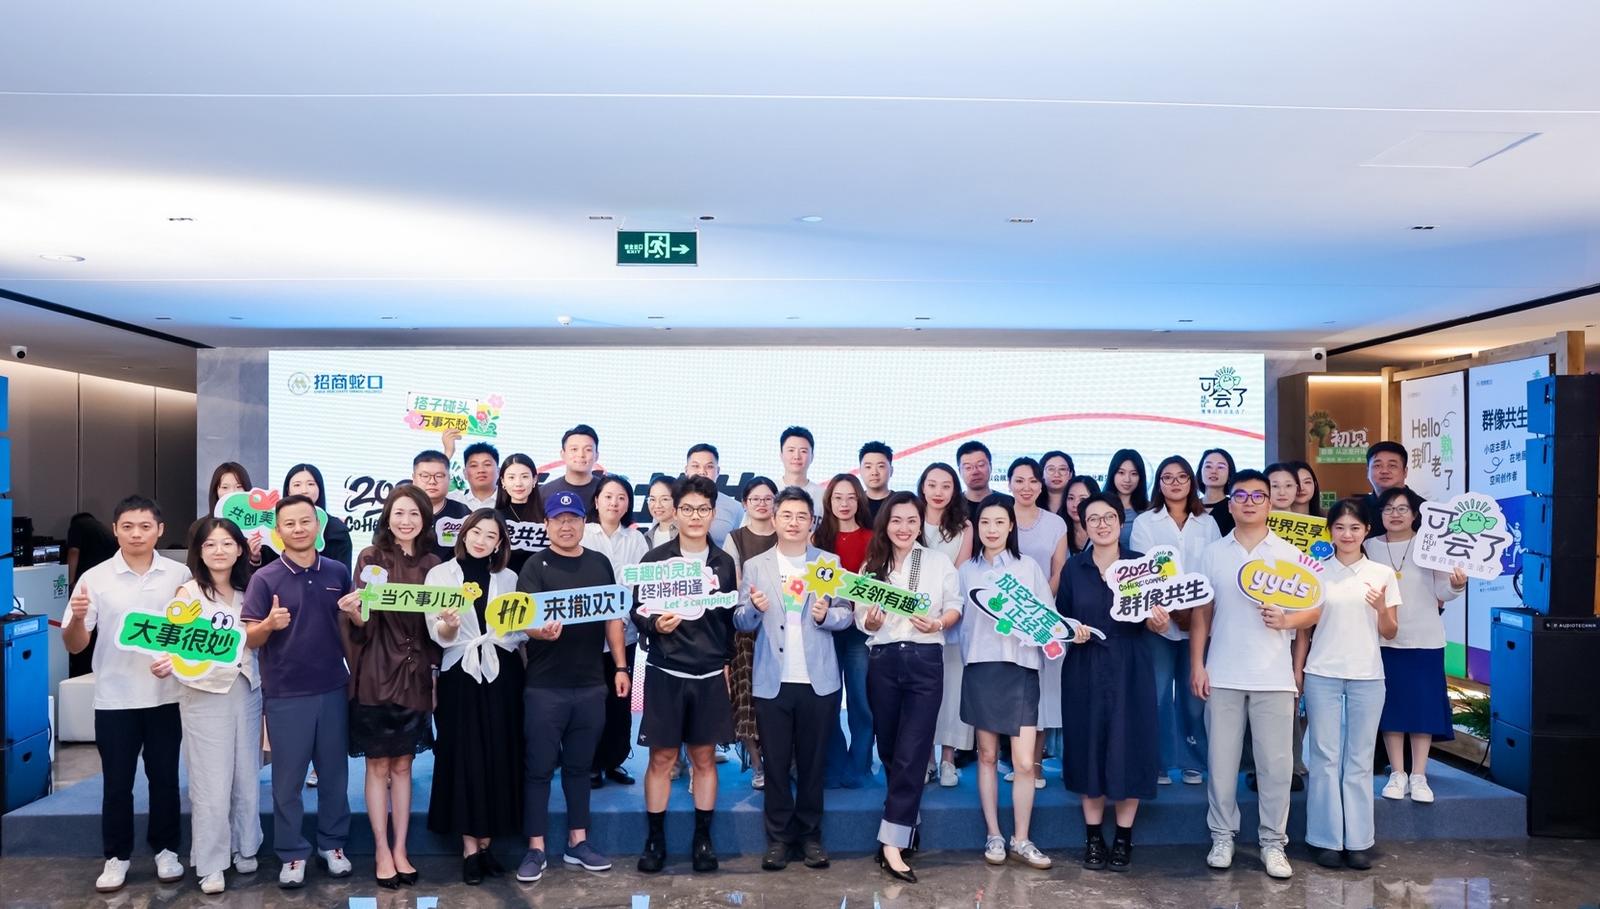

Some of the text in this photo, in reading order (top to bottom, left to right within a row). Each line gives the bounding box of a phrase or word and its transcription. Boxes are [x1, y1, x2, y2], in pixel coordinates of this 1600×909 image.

[314, 374, 383, 389] 招商蛇口
[414, 395, 470, 414] 搭子碰头
[418, 414, 468, 431] 万事不愁
[1412, 417, 1440, 439] Hello
[1482, 405, 1528, 431] 群像共生
[1331, 431, 1369, 448] 初见
[1489, 471, 1517, 486] 空间创作者
[228, 505, 274, 526] 共创美
[1265, 516, 1324, 538] 世界尽享
[623, 561, 702, 583] 有趣的灵魂
[1117, 559, 1162, 580] 2026
[381, 589, 465, 608] 当个事儿办
[641, 579, 703, 600] 终将相逢
[1117, 579, 1209, 616] 群像共生
[690, 594, 736, 607] camping!
[995, 573, 1061, 631] 放空才是
[497, 596, 529, 630] Hi
[1005, 604, 1054, 645] 正经事
[127, 620, 234, 656] 大事很妙
